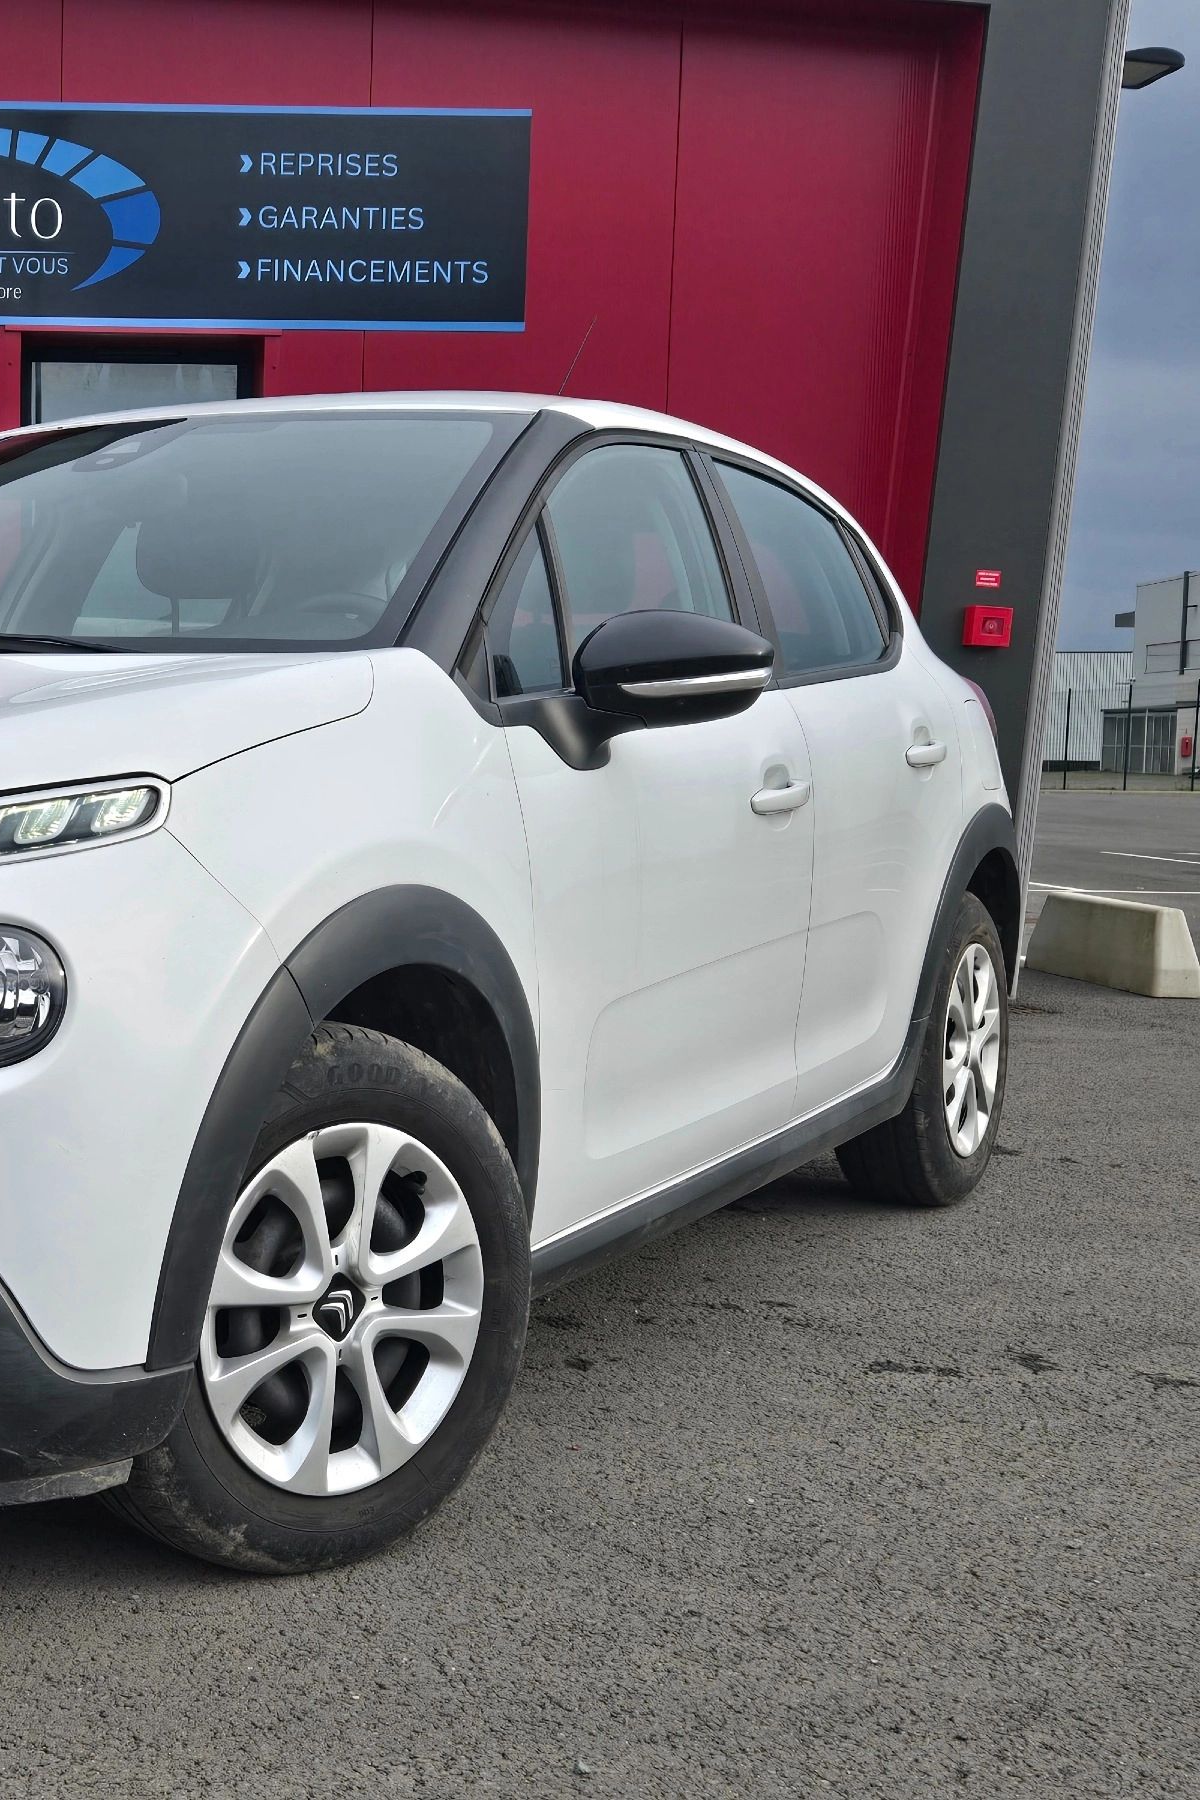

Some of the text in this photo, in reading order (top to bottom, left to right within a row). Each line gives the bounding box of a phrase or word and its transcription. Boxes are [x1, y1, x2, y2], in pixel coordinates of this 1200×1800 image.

[260, 152, 399, 177] REPRISES
[258, 205, 424, 230] GARANTIES
[12, 257, 69, 275] VOUS
[257, 258, 489, 284] FINANCEMENTS
